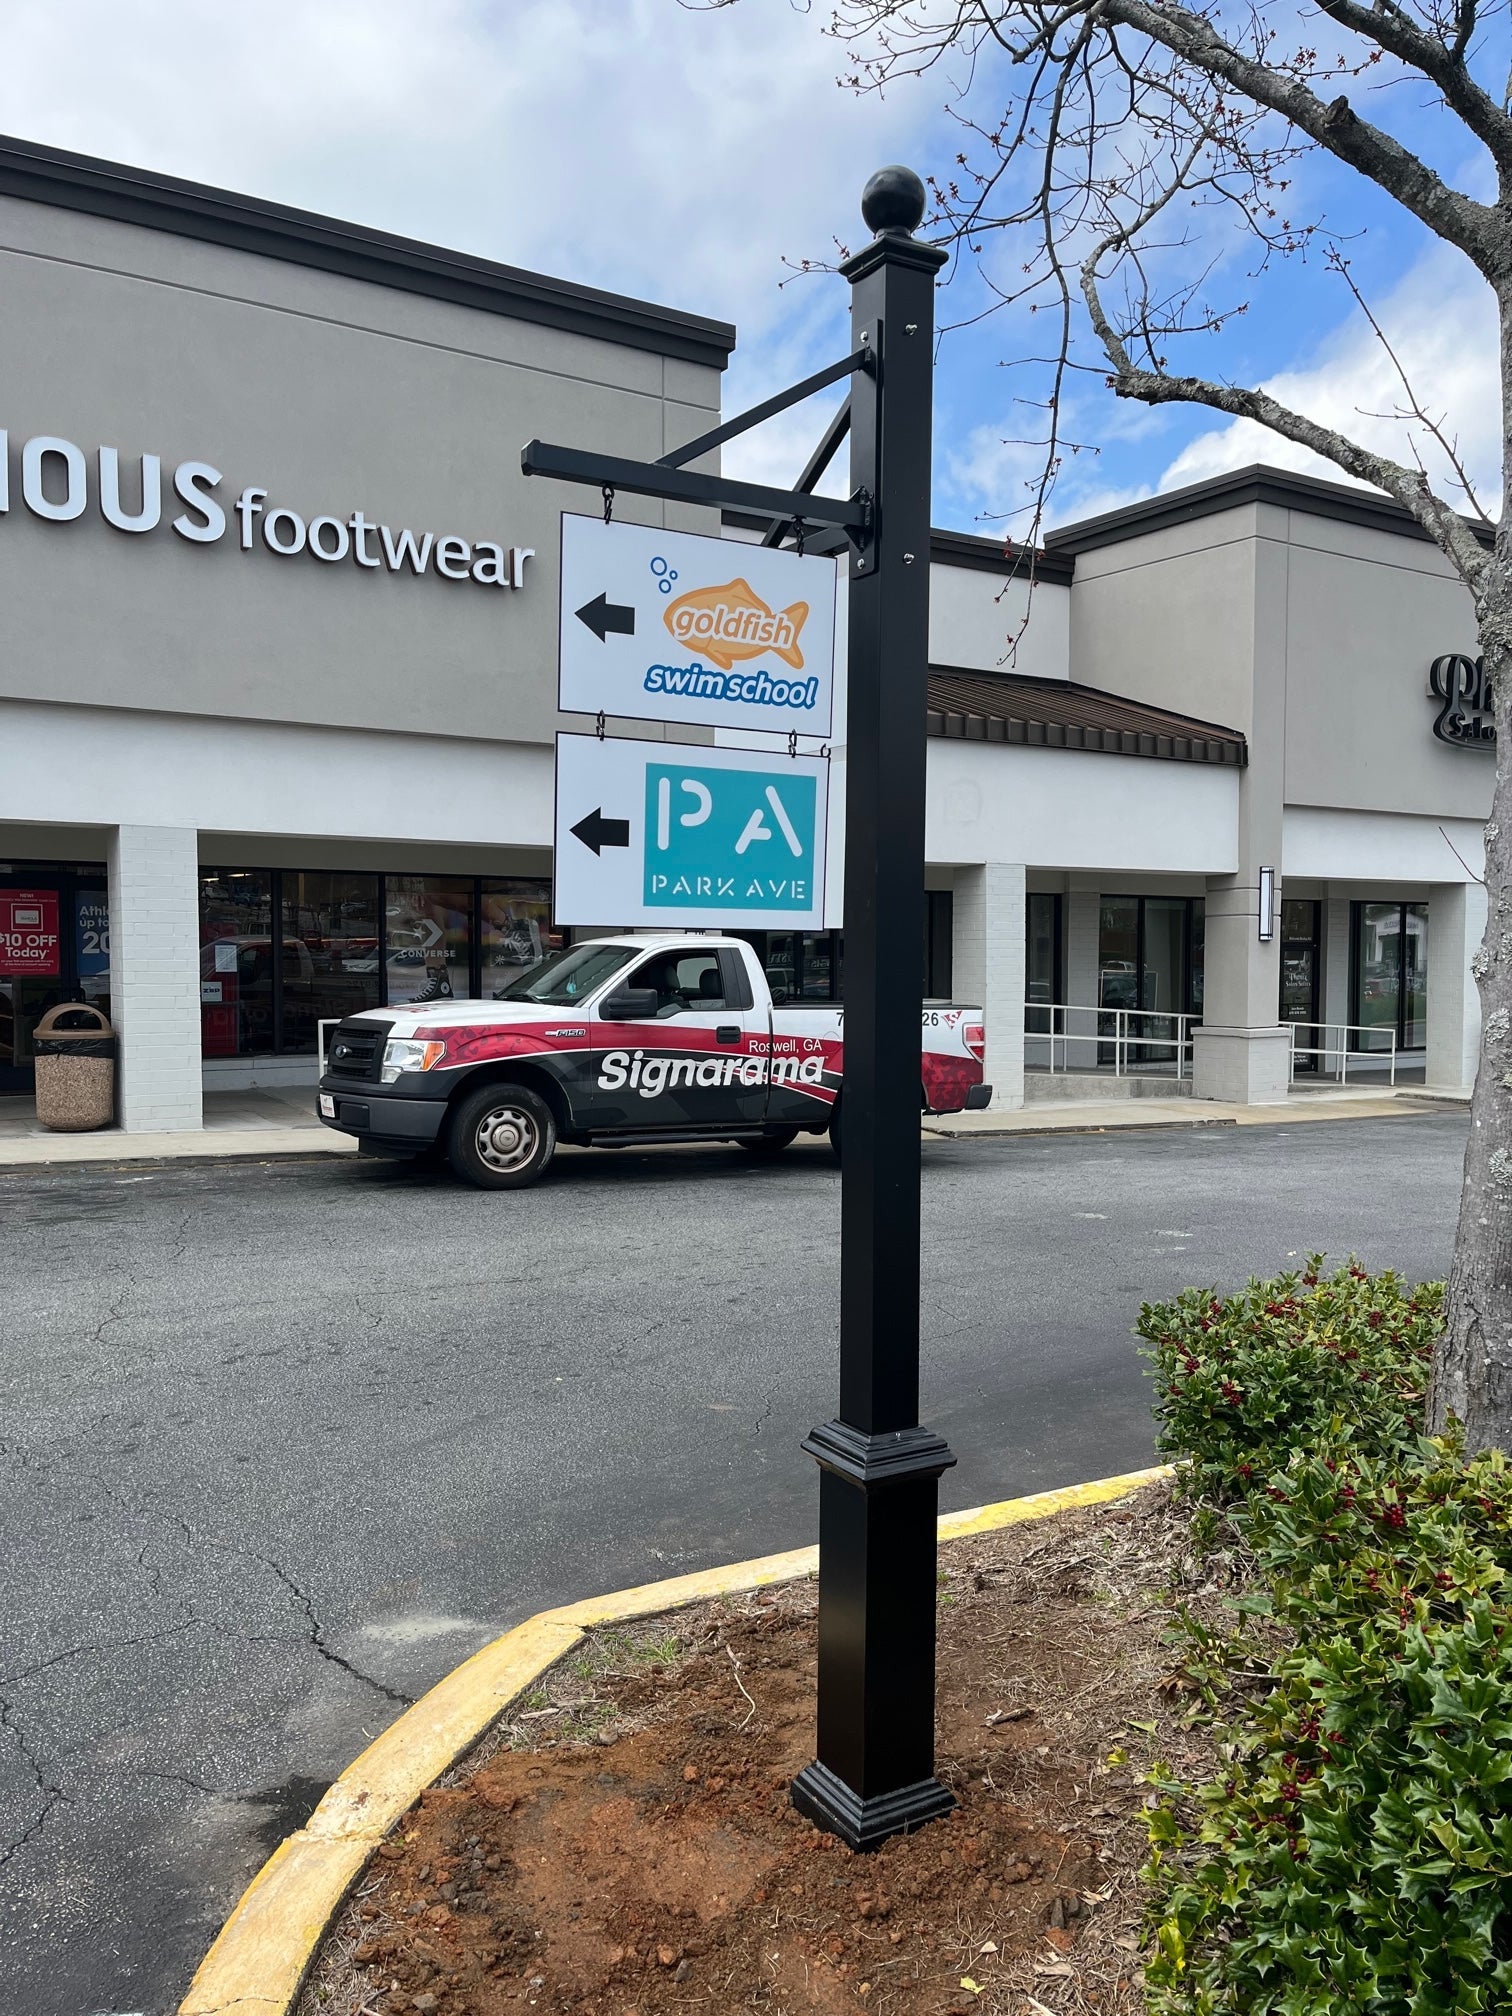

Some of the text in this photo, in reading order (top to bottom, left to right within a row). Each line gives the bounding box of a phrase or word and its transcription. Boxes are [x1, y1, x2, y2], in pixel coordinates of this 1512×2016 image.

[235, 486, 535, 588] footwear
[675, 608, 792, 645] goldfish
[652, 875, 806, 899] PARK AVE
[79, 905, 109, 917] Athl
[26, 935, 57, 947] OFF
[402, 949, 457, 958] CONVERSE
[749, 1038, 822, 1053] Roswell, GA
[597, 1049, 825, 1098] Signarama
